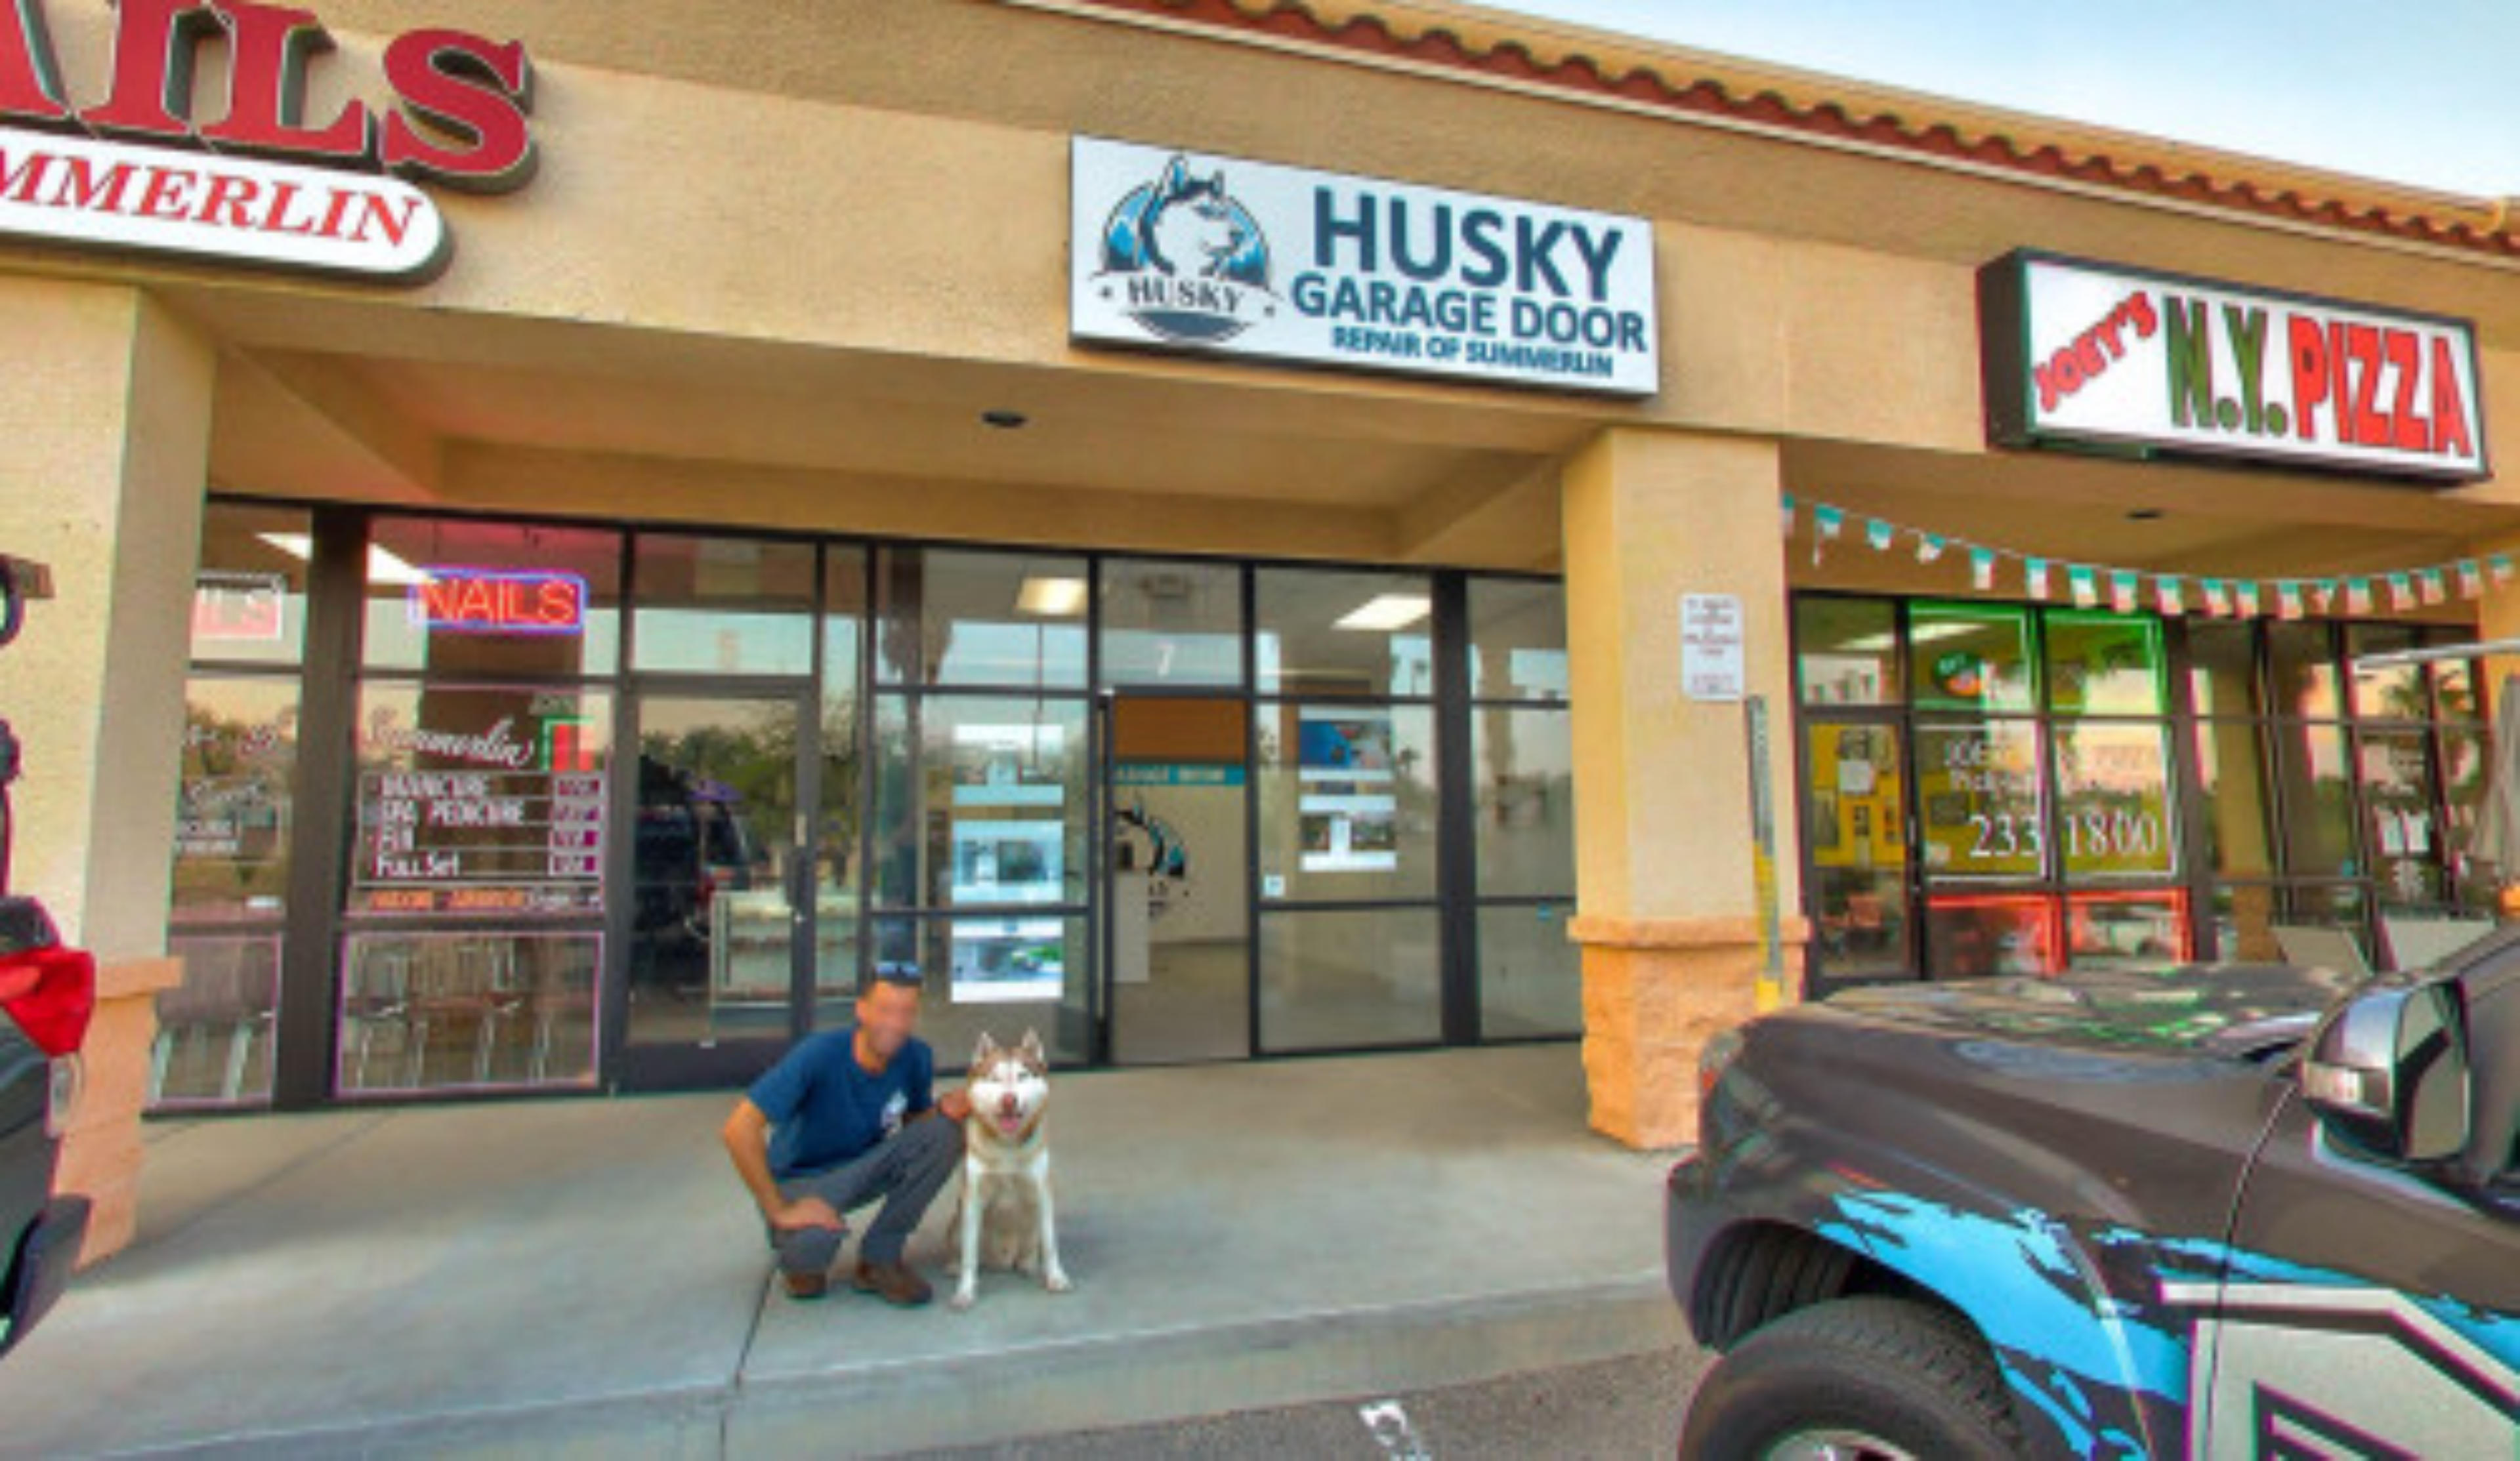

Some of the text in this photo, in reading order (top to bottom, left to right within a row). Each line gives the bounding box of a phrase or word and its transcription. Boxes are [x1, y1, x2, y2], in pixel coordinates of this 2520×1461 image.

[0, 148, 422, 248] MMERLIN
[1313, 186, 1624, 302] HUSKY
[1127, 276, 1247, 315] HUSKY
[1291, 270, 1648, 353] GARAGE DOOR
[1332, 325, 1614, 377] REPAIR OF SUMMERLIN
[2033, 289, 2159, 413] JOEY'S
[2288, 311, 2474, 457] PIZZA
[417, 577, 576, 626] NAILS
[2066, 808, 2160, 857] 1800
